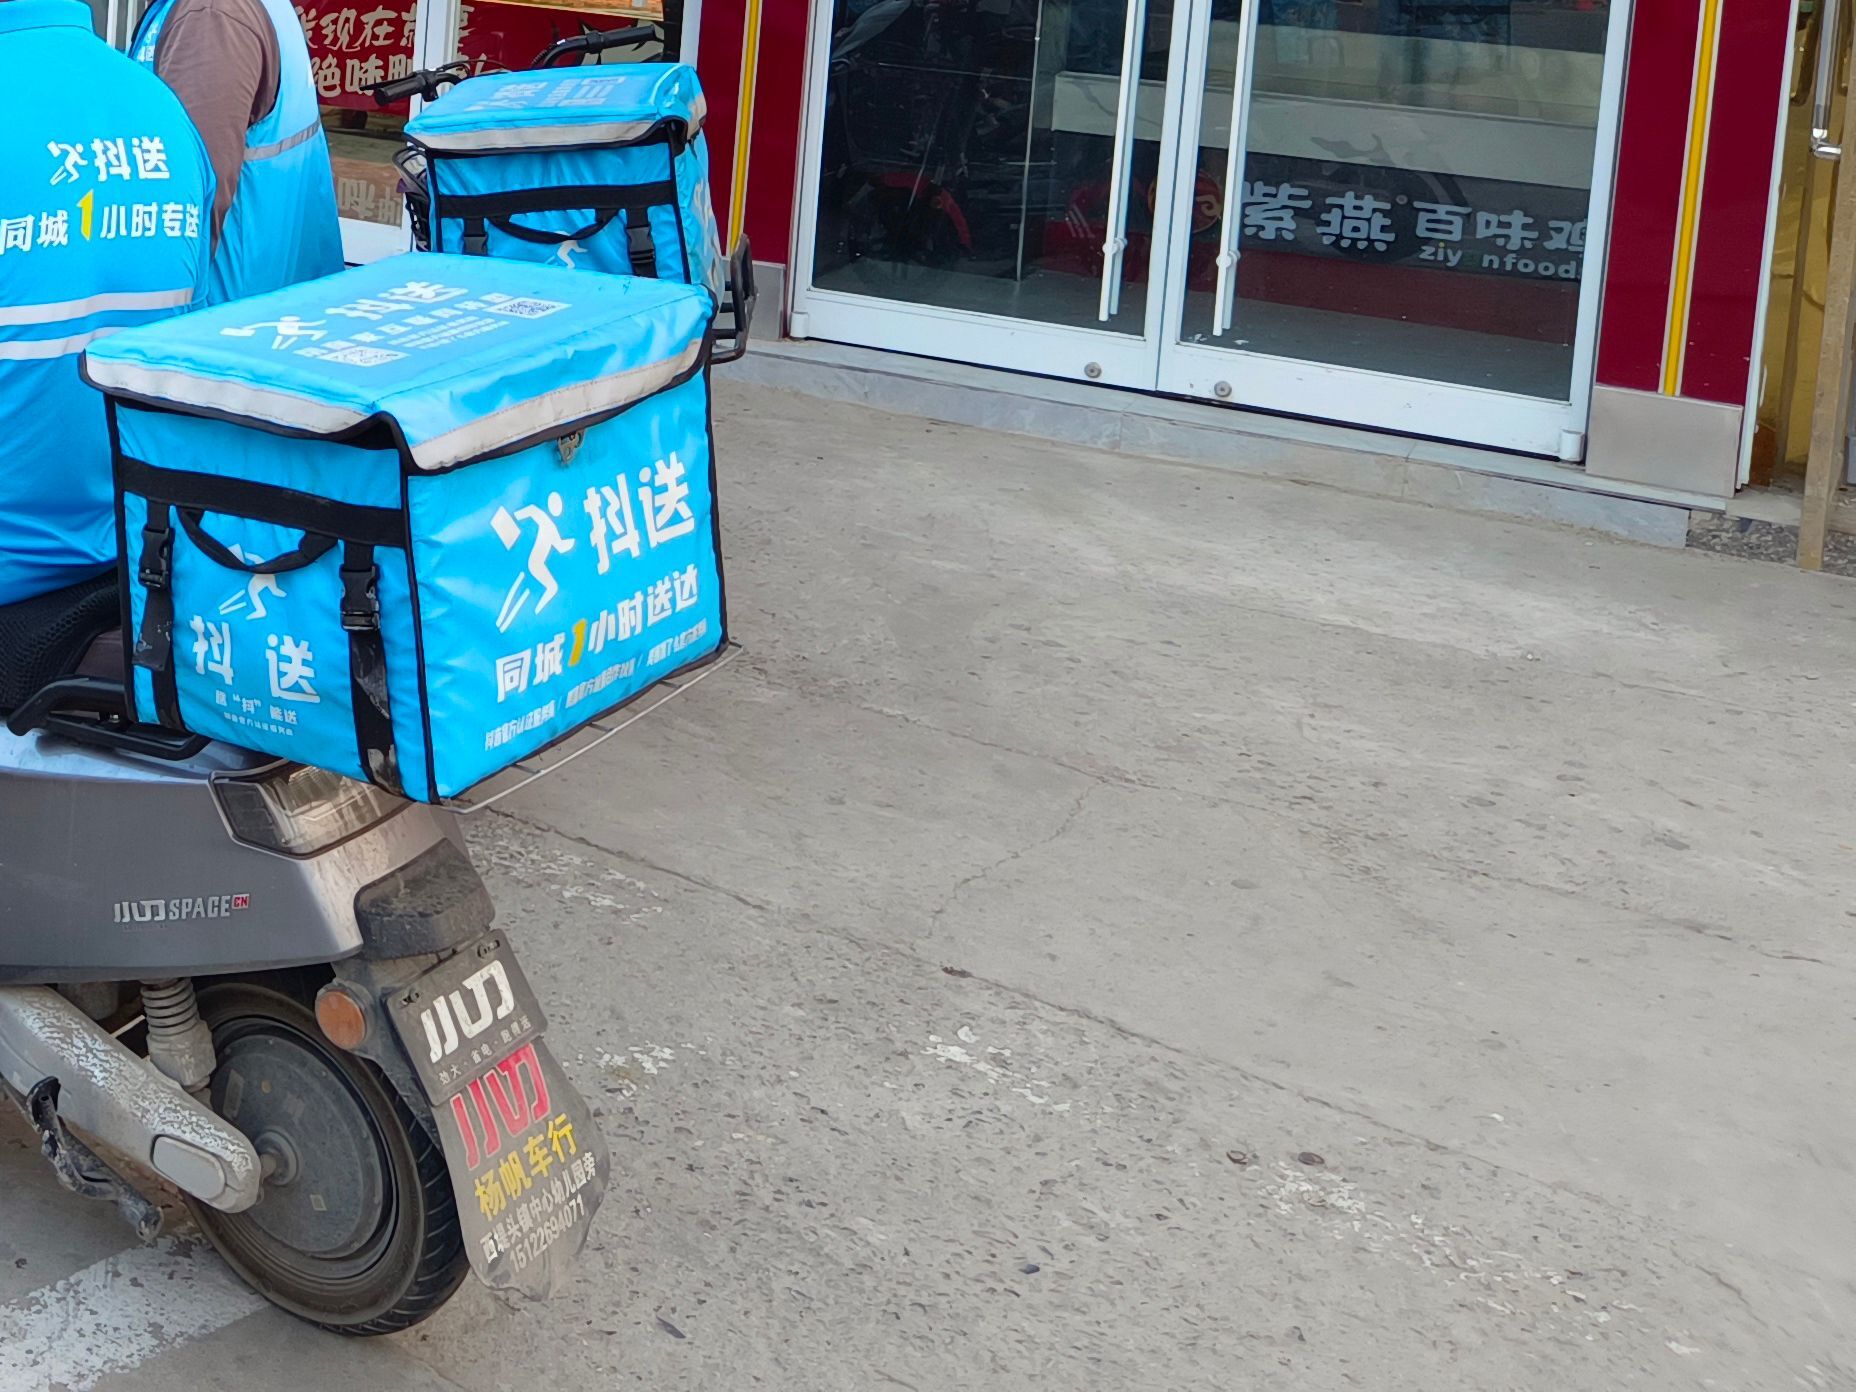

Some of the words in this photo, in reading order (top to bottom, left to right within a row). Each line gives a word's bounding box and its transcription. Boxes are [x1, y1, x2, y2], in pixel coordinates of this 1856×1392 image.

[91, 135, 171, 183] 抖送
[583, 451, 697, 575] 抖送
[189, 614, 321, 704] 抖送
[495, 563, 701, 703] 同城1小时送达
[168, 895, 231, 921] SPACE
[474, 1112, 578, 1222] 杨帆车行
[509, 1193, 585, 1274] 15122694071
